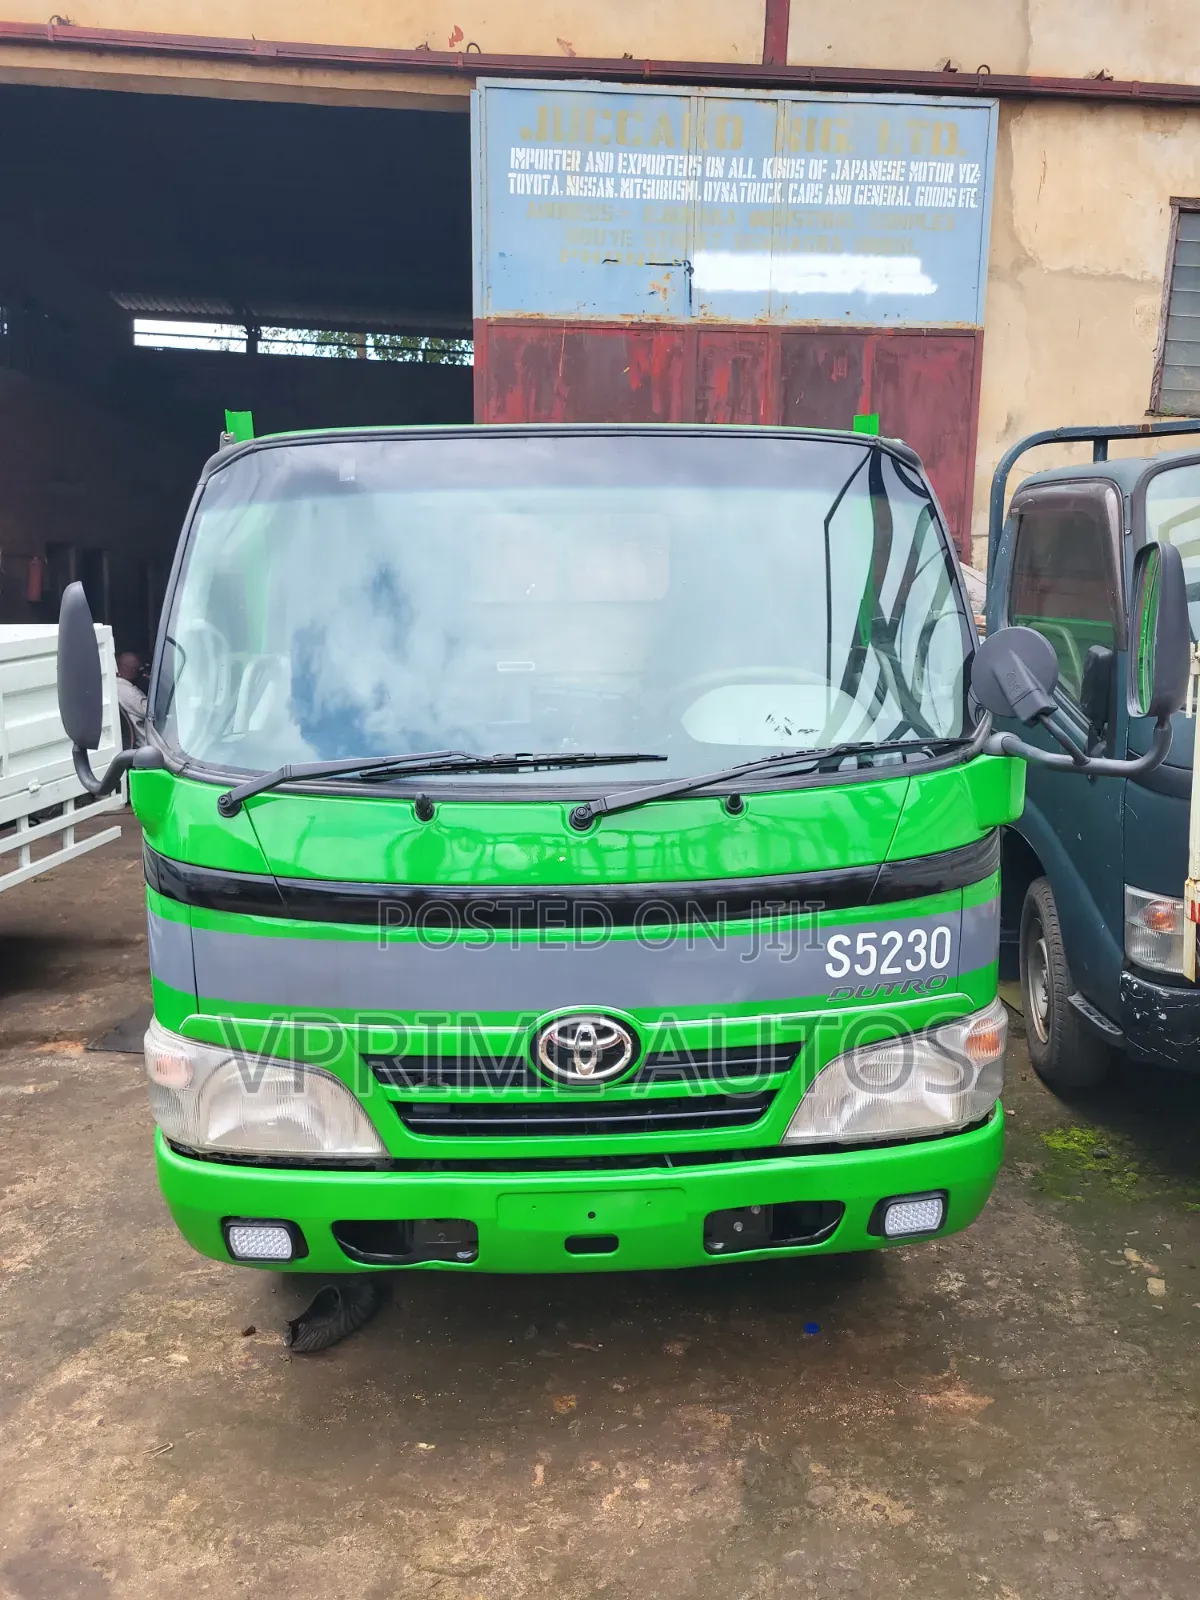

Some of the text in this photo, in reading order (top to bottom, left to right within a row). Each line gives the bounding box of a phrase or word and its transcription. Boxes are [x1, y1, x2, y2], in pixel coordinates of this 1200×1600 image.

[510, 147, 581, 171] IMPORTER
[584, 151, 614, 173] AND
[617, 153, 702, 177] EXPORTERS
[705, 156, 725, 178] ON
[728, 158, 756, 179] ALL
[762, 157, 805, 179] KINDS
[808, 159, 828, 180] OF
[831, 160, 906, 181] JAPANESE
[908, 161, 954, 183] MOTOR
[507, 172, 563, 196] TOYOTA,
[566, 175, 618, 198] NISSAN,
[789, 182, 823, 204] CARS
[825, 184, 852, 205] AND
[854, 184, 912, 207] GENERAL
[914, 185, 957, 208] GOODS
[825, 926, 951, 978] S5230
[827, 974, 948, 1002] DUTRO
